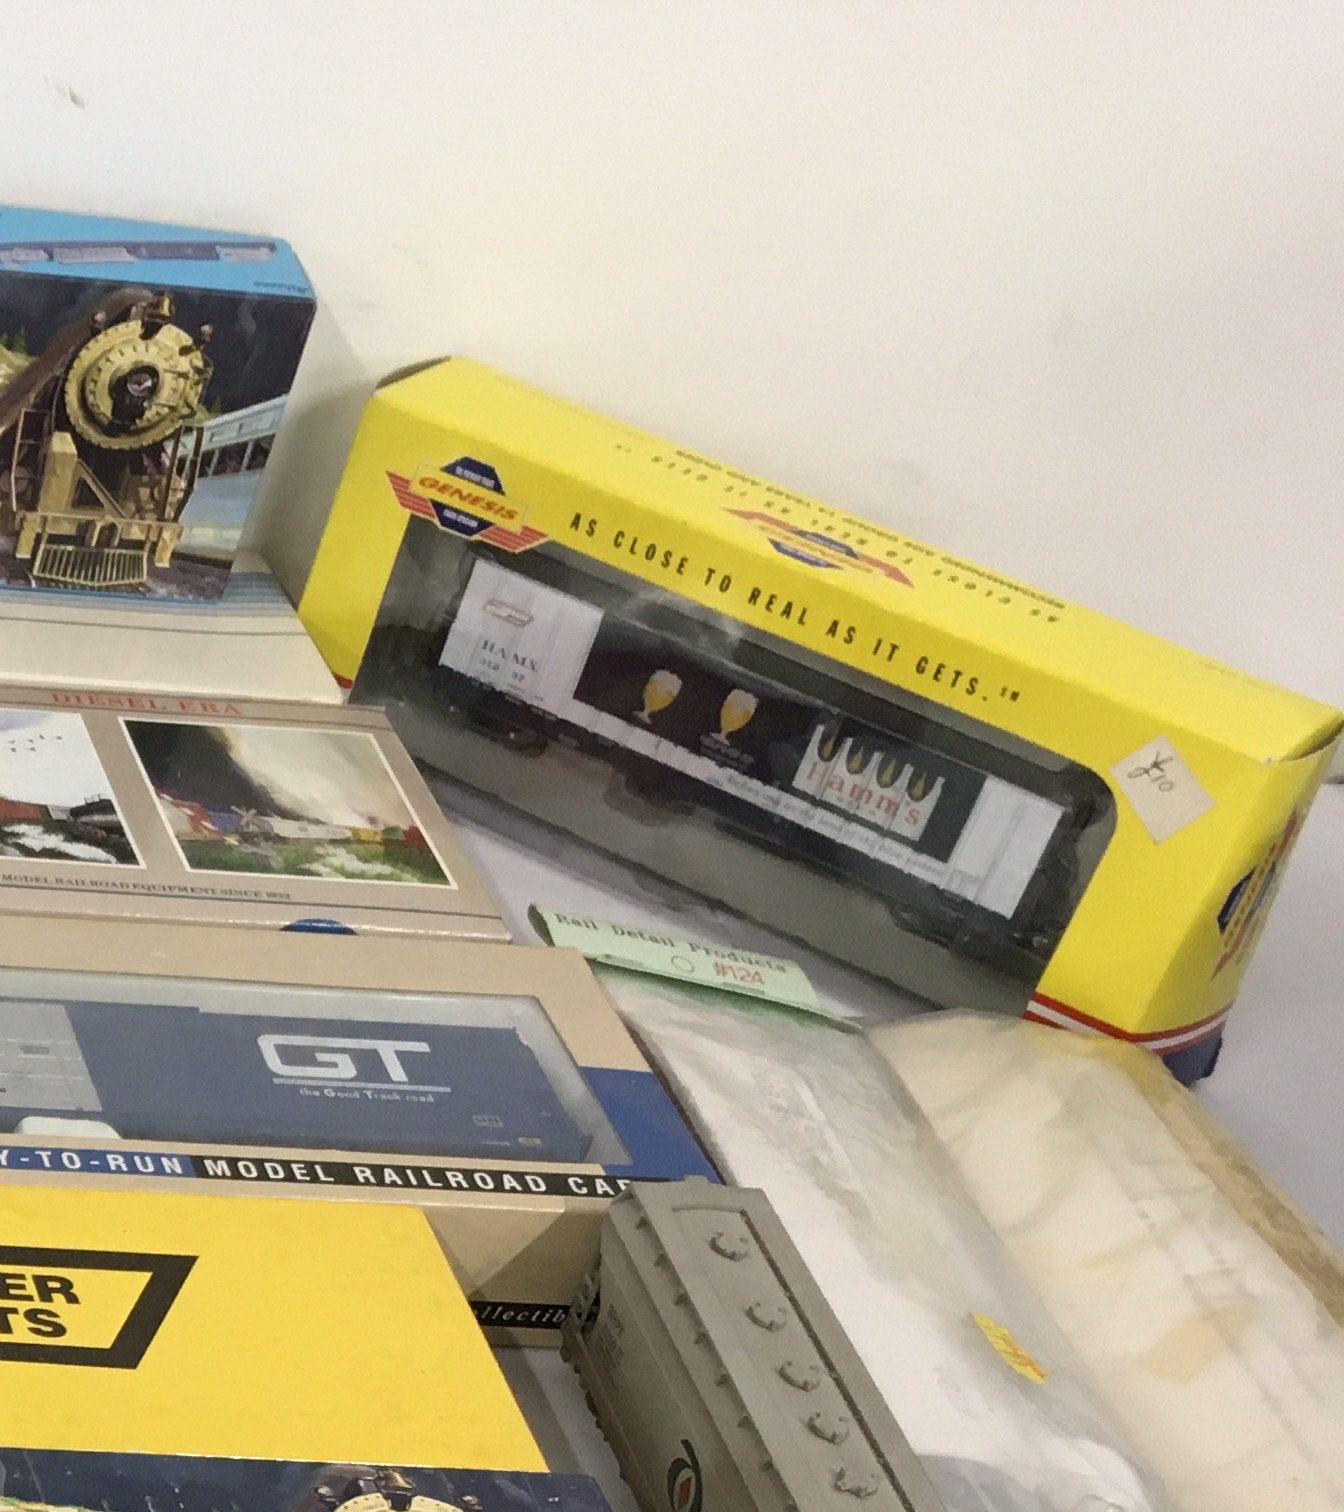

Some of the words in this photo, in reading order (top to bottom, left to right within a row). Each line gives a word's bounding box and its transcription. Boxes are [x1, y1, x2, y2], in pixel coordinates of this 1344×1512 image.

[418, 475, 519, 521] GENESIS
[568, 511, 599, 539] AS
[613, 528, 689, 577] CLOSE
[704, 566, 733, 595] TO
[747, 585, 810, 627] REAL
[824, 618, 859, 647] AS
[872, 637, 901, 665] IT
[51, 691, 167, 711] DIESEL
[178, 700, 243, 716] ERA
[553, 911, 598, 933] Rail
[612, 924, 675, 949] Detail
[688, 941, 788, 975] Products
[256, 1033, 431, 1083] GT
[205, 1158, 335, 1183] MODEL
[352, 1165, 548, 1193] RAILROAD
